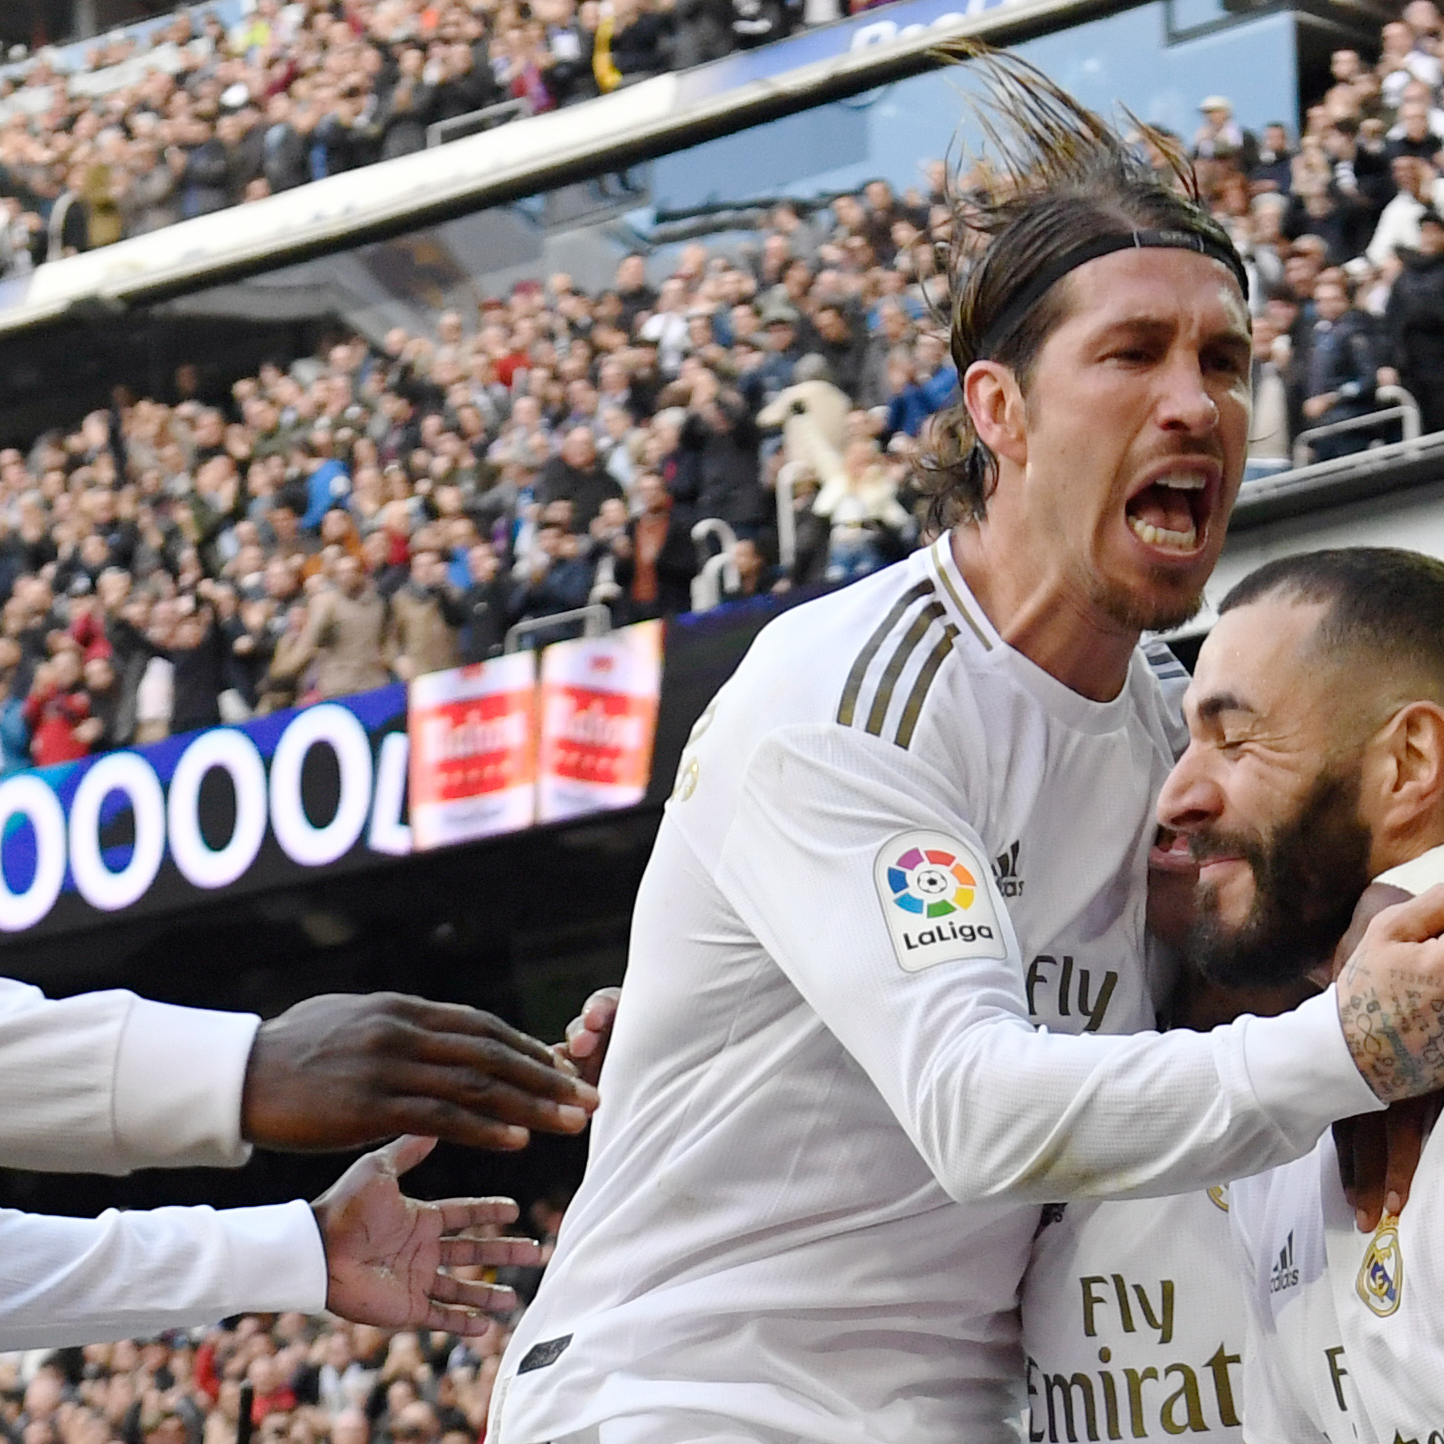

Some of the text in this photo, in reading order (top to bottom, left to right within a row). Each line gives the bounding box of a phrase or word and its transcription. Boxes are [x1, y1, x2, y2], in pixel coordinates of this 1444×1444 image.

[903, 921, 994, 950] LaLiga
[1025, 955, 1119, 1032] Fly
[1078, 1273, 1175, 1344] Fly
